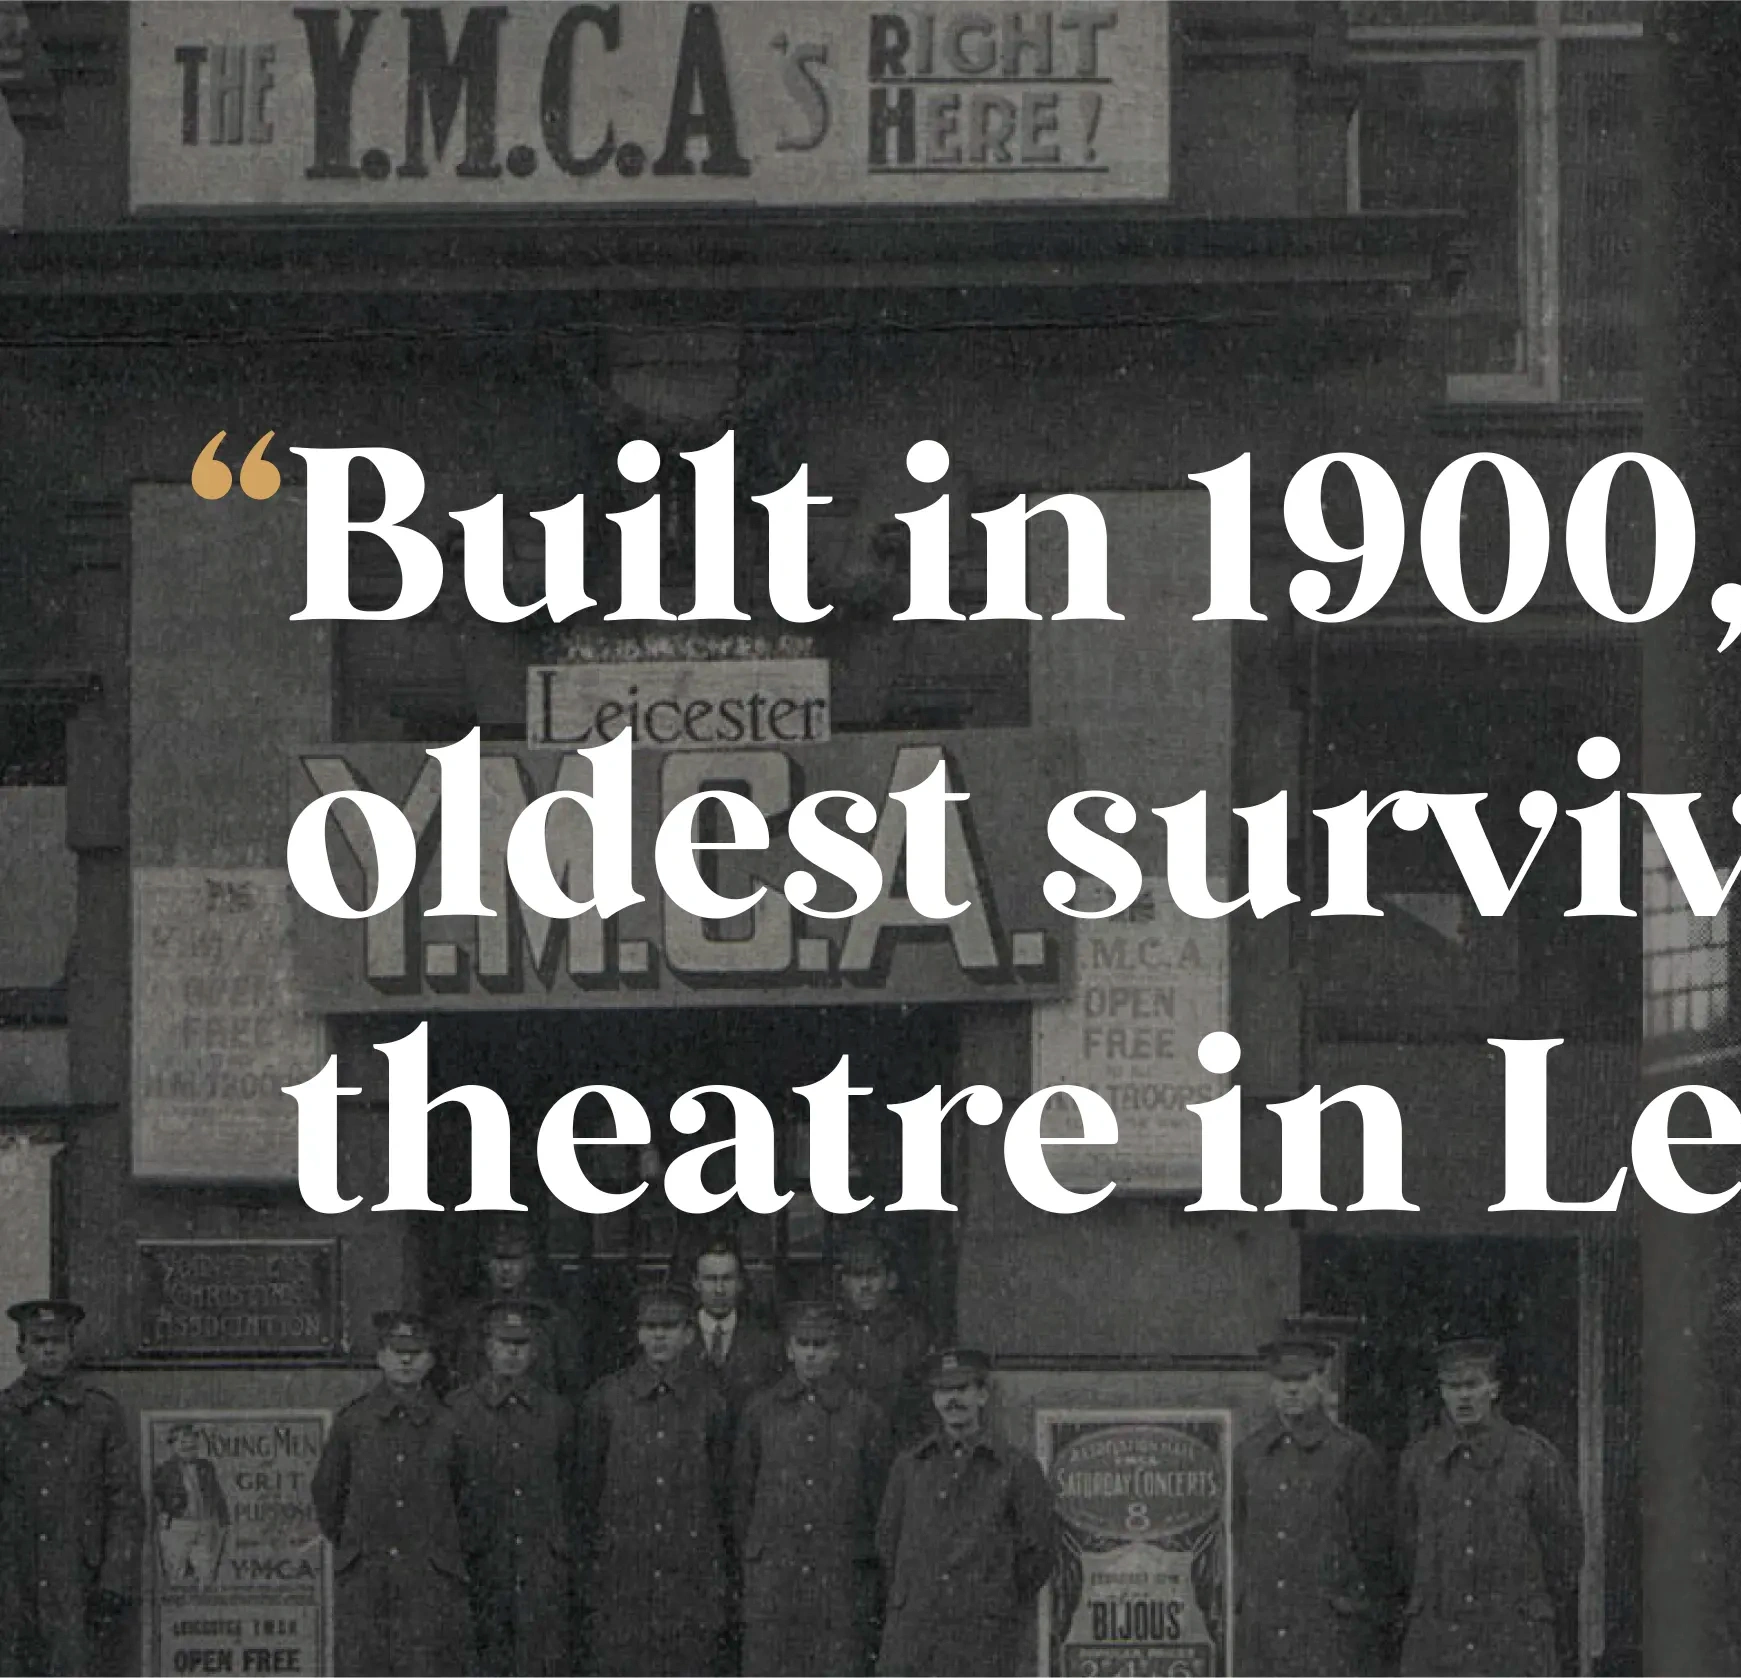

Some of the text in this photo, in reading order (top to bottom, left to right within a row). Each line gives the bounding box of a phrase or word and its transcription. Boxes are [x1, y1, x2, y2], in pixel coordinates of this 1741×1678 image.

[868, 10, 1118, 80] RIGHT
[173, 45, 275, 146] THE
[868, 88, 1103, 165] HERE!
[536, 670, 825, 744] Leicester
[1084, 986, 1176, 1019] OPEN
[1083, 1028, 1176, 1060] FREE
[236, 1471, 306, 1491] GRIT
[1133, 1466, 1216, 1498] CONCERTS
[1124, 1501, 1151, 1531] 8
[173, 1648, 301, 1674] OPEN FREE
